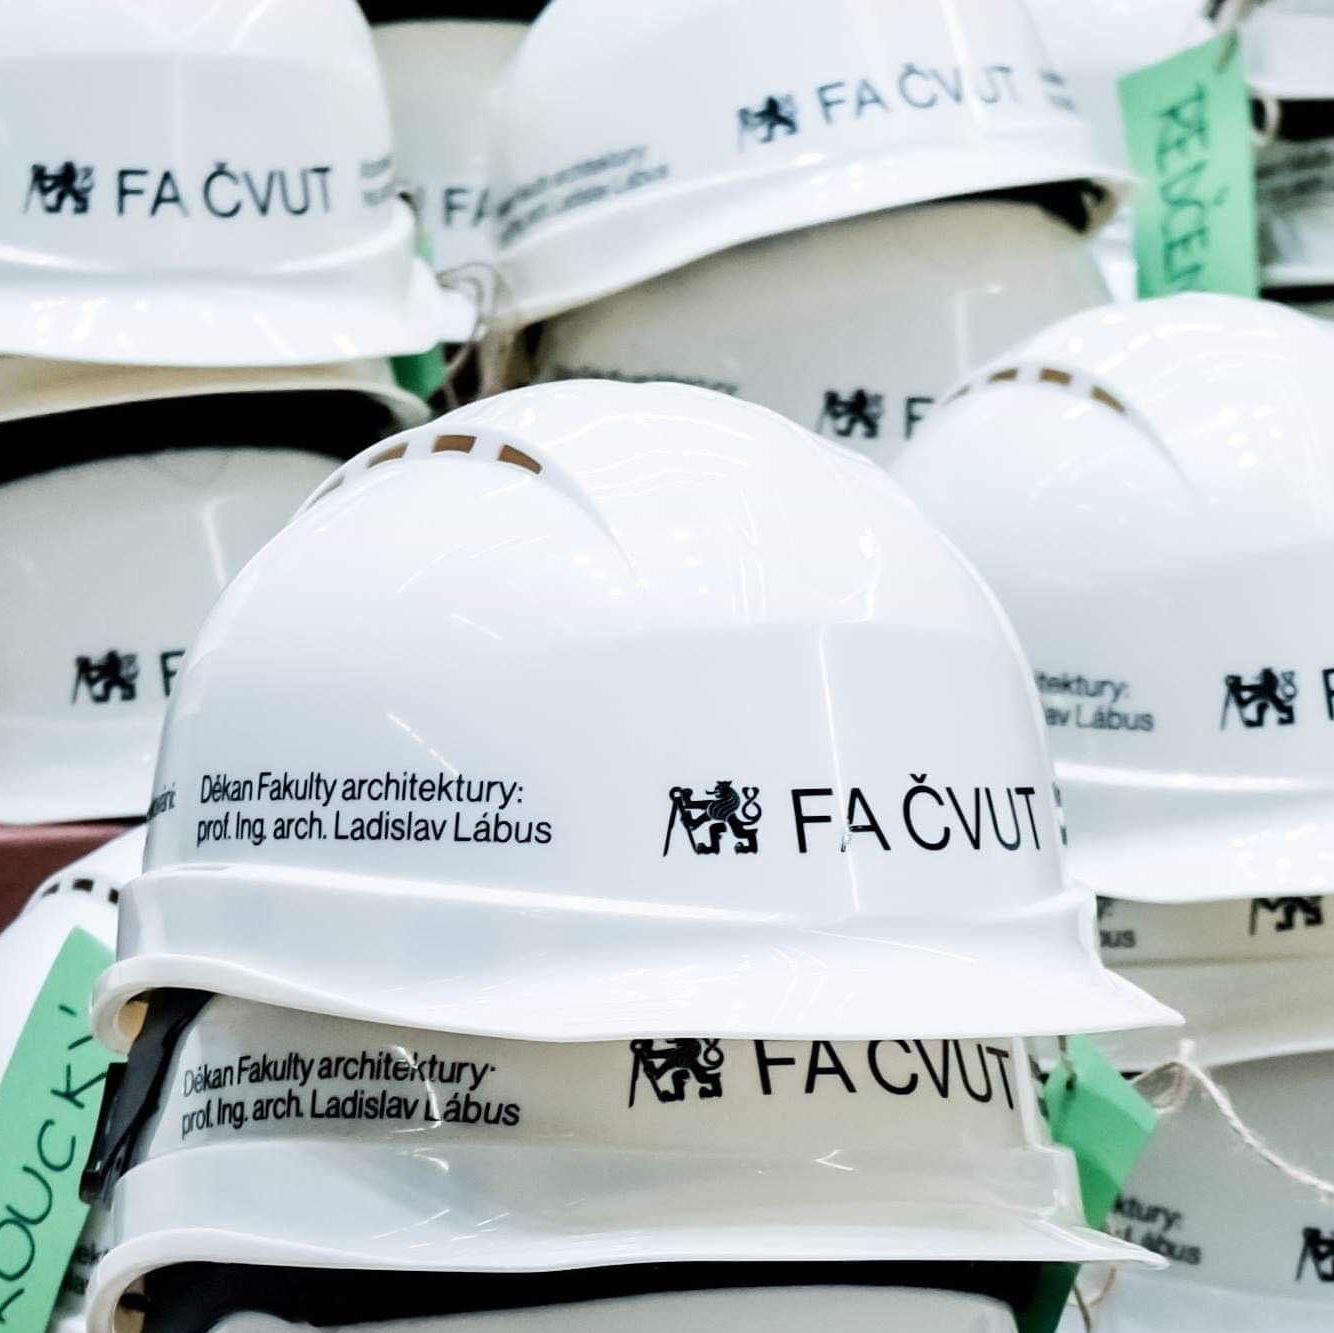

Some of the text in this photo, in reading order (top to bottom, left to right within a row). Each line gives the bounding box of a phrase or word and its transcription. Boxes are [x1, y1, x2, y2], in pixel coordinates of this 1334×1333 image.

[819, 78, 889, 126] FA
[117, 168, 188, 217] FA
[204, 161, 333, 218] ČVUT
[200, 774, 254, 804] Děkan
[256, 771, 338, 807] Fakulty
[341, 770, 525, 810] architektury:
[790, 773, 1043, 854] FA ČVUT
[196, 810, 553, 848] prof. Ing. arch. Ladislav Lábus
[183, 1063, 234, 1097] Děkan
[237, 1051, 315, 1088] Fakulty
[181, 1088, 521, 1140] prof. Ing. arch. Ladislav Lábus
